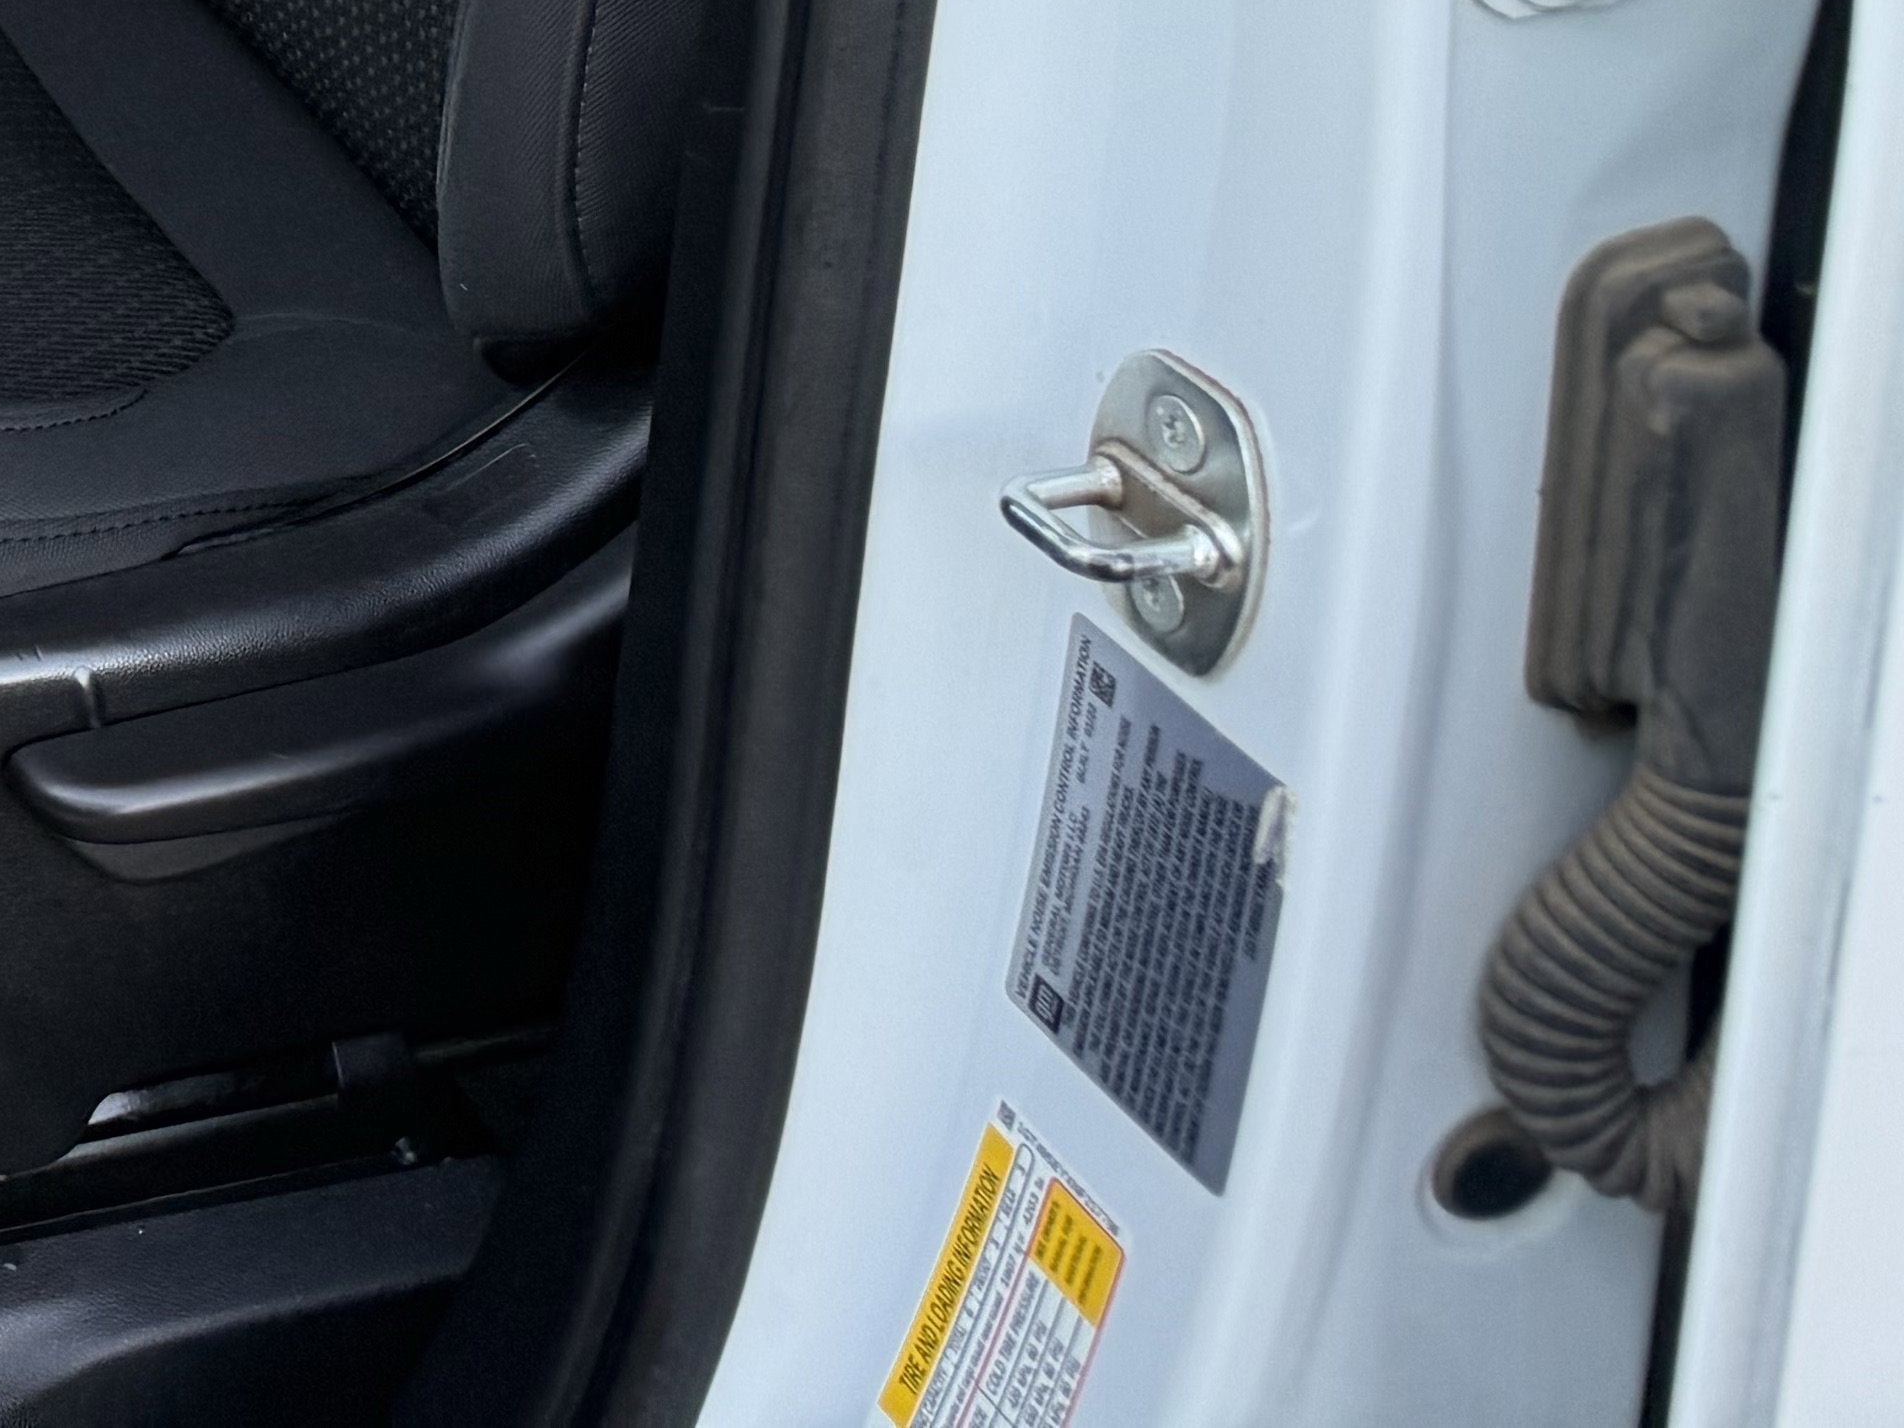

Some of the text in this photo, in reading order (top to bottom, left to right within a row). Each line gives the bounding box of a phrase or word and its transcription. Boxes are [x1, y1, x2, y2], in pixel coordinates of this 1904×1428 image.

[1016, 635, 1095, 1003] VEHICLE NOISE EMISSION CONTROL INFORMATION
[952, 1164, 998, 1266] INFORMATION
[927, 1260, 964, 1331] LOADING
[911, 1324, 939, 1364] AND
[898, 1357, 926, 1395] TIRE
[984, 1359, 1006, 1396] COLD
